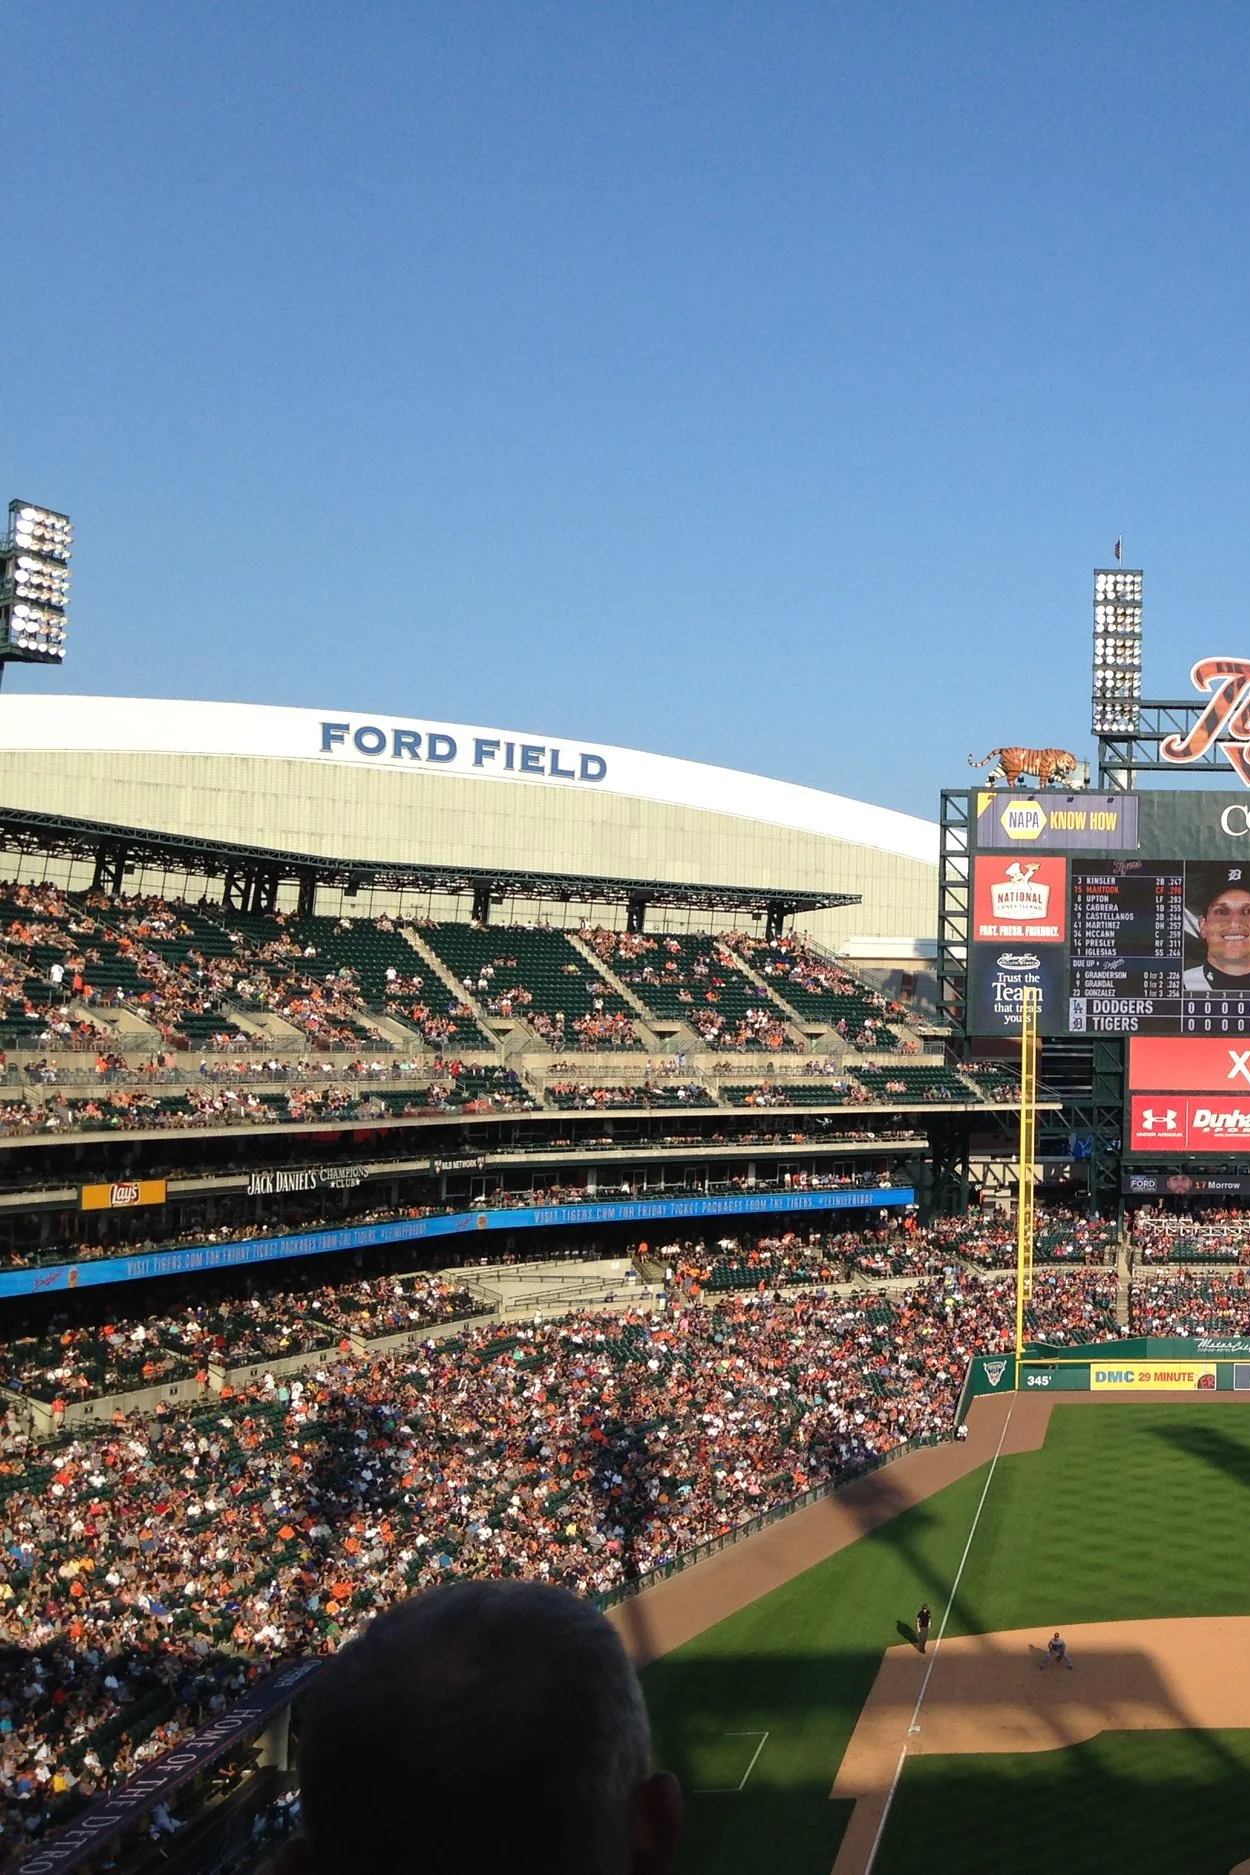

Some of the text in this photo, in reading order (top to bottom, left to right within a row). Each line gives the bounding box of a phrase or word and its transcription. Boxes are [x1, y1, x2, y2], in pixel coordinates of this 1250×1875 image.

[319, 722, 607, 782] FORD FIELD
[1009, 811, 1117, 831] NAPA KNOW HOW
[998, 892, 1042, 904] NATIONAL
[1086, 930, 1115, 938] MCCANN
[1086, 939, 1116, 947] PRESLEY
[1085, 948, 1116, 956] IGLESIAS
[997, 973, 1040, 982] Trust the
[1085, 971, 1127, 979] GRANDERSON
[1085, 980, 1114, 988] GRANDAL
[1085, 989, 1116, 997] GONZALEZ
[994, 1003, 1042, 1012] that tras
[1093, 1000, 1153, 1014] DODGERS
[1004, 1014, 1031, 1024] yous
[1093, 1017, 1139, 1031] TIGERS
[320, 1166, 368, 1182] CHAMPIONS
[247, 1171, 316, 1195] JACK DANIEL'S
[336, 1180, 356, 1188] CLUB
[1208, 1181, 1240, 1189] Morrow
[111, 1184, 138, 1204] Lay's
[534, 1211, 558, 1224] VISIT
[638, 1204, 667, 1216] FRIDAY
[670, 1202, 698, 1214] TICKET
[1027, 1375, 1052, 1386] 345'
[1095, 1371, 1194, 1383] DMC 29 MINUTE
[188, 1708, 262, 1750] HOME
[157, 1753, 197, 1772] OF
[104, 1776, 168, 1808] THE
